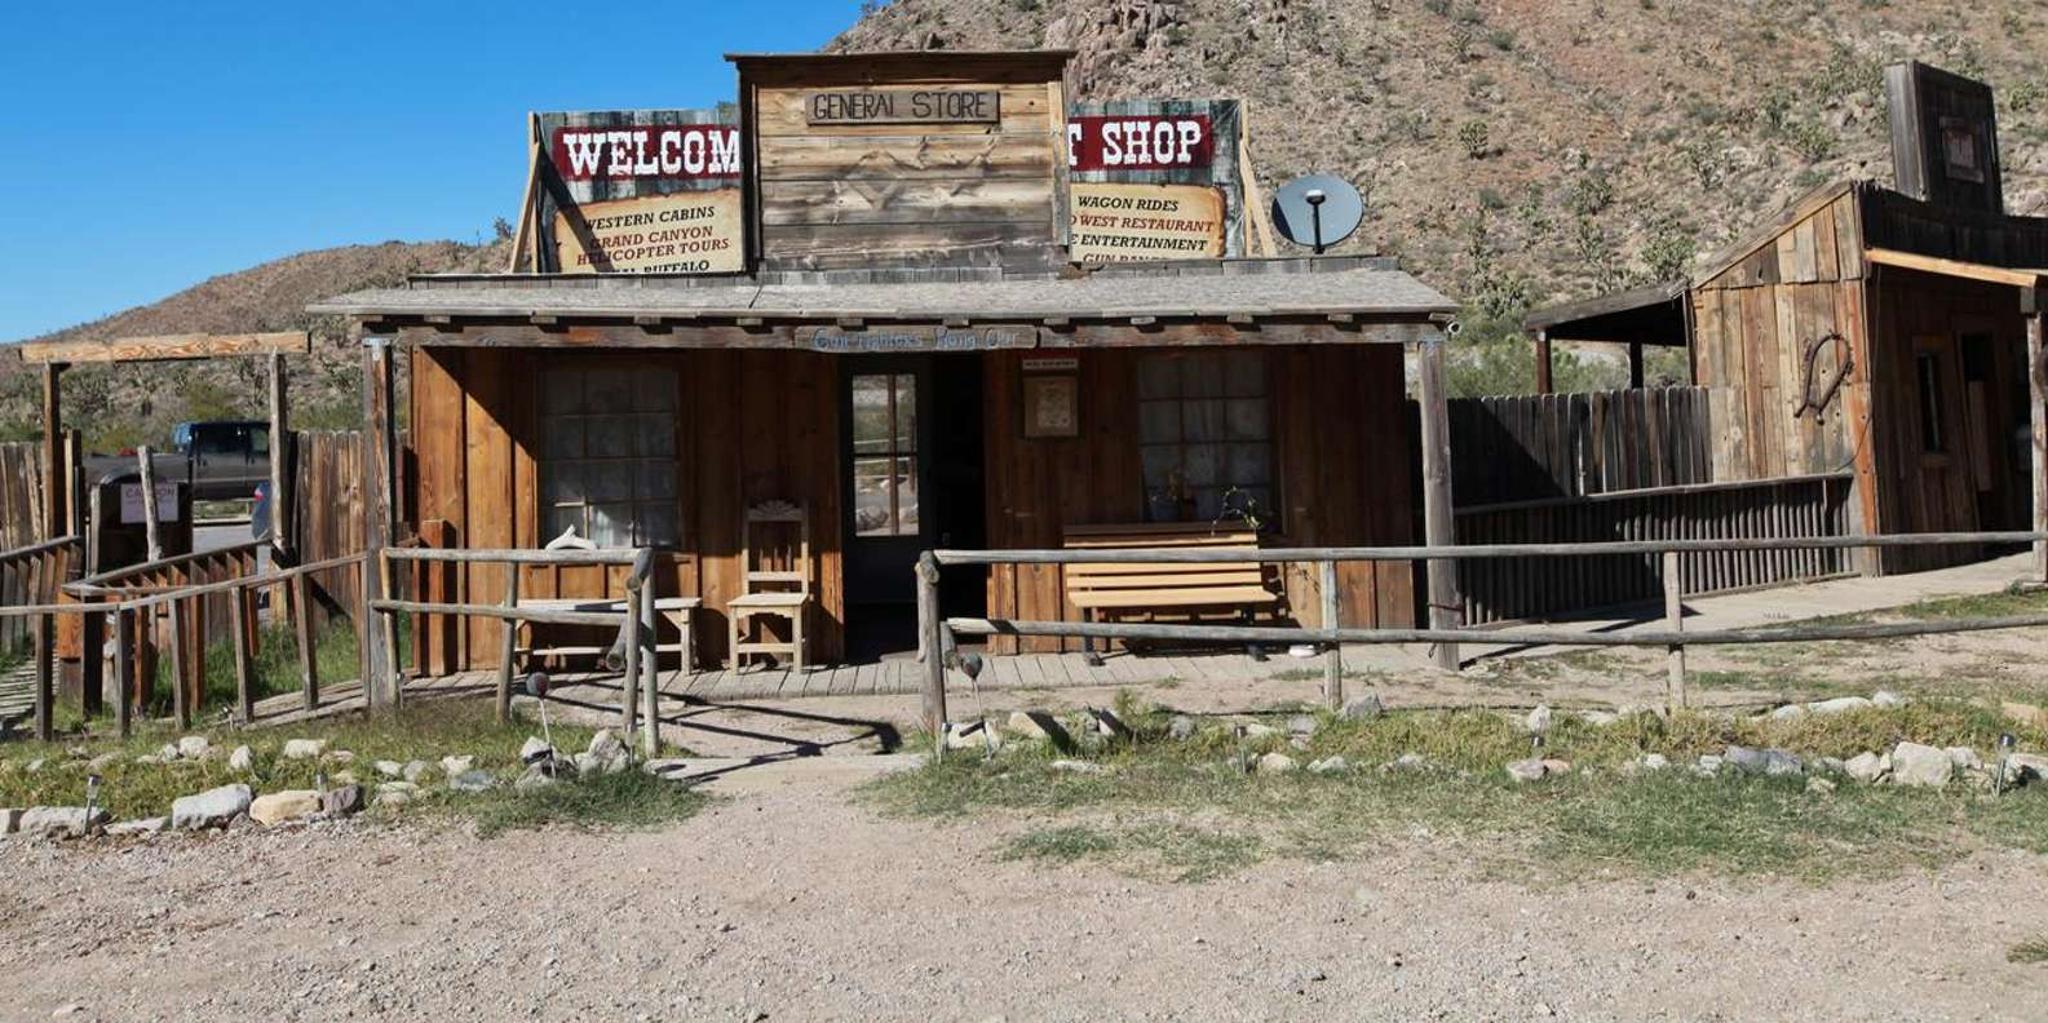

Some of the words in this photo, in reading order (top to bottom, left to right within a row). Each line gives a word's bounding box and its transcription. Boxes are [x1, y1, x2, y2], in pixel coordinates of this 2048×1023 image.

[813, 93, 895, 120] GENERAL
[912, 91, 988, 119] STORE
[563, 130, 740, 176] WELCOM
[1102, 120, 1202, 165] SHOP
[1078, 196, 1134, 210] WAGON
[1136, 197, 1179, 212] RIDES
[584, 212, 655, 230] WESTERN
[659, 206, 715, 223] CABINS
[1080, 214, 1119, 229] WEST
[1121, 217, 1214, 233] RESTAURANT
[591, 233, 644, 250] GRAND
[649, 226, 713, 244] CANYON
[1081, 234, 1207, 251] ENTERTAINMENT
[577, 244, 675, 266] HELICOPTER
[679, 238, 729, 256] TOURS
